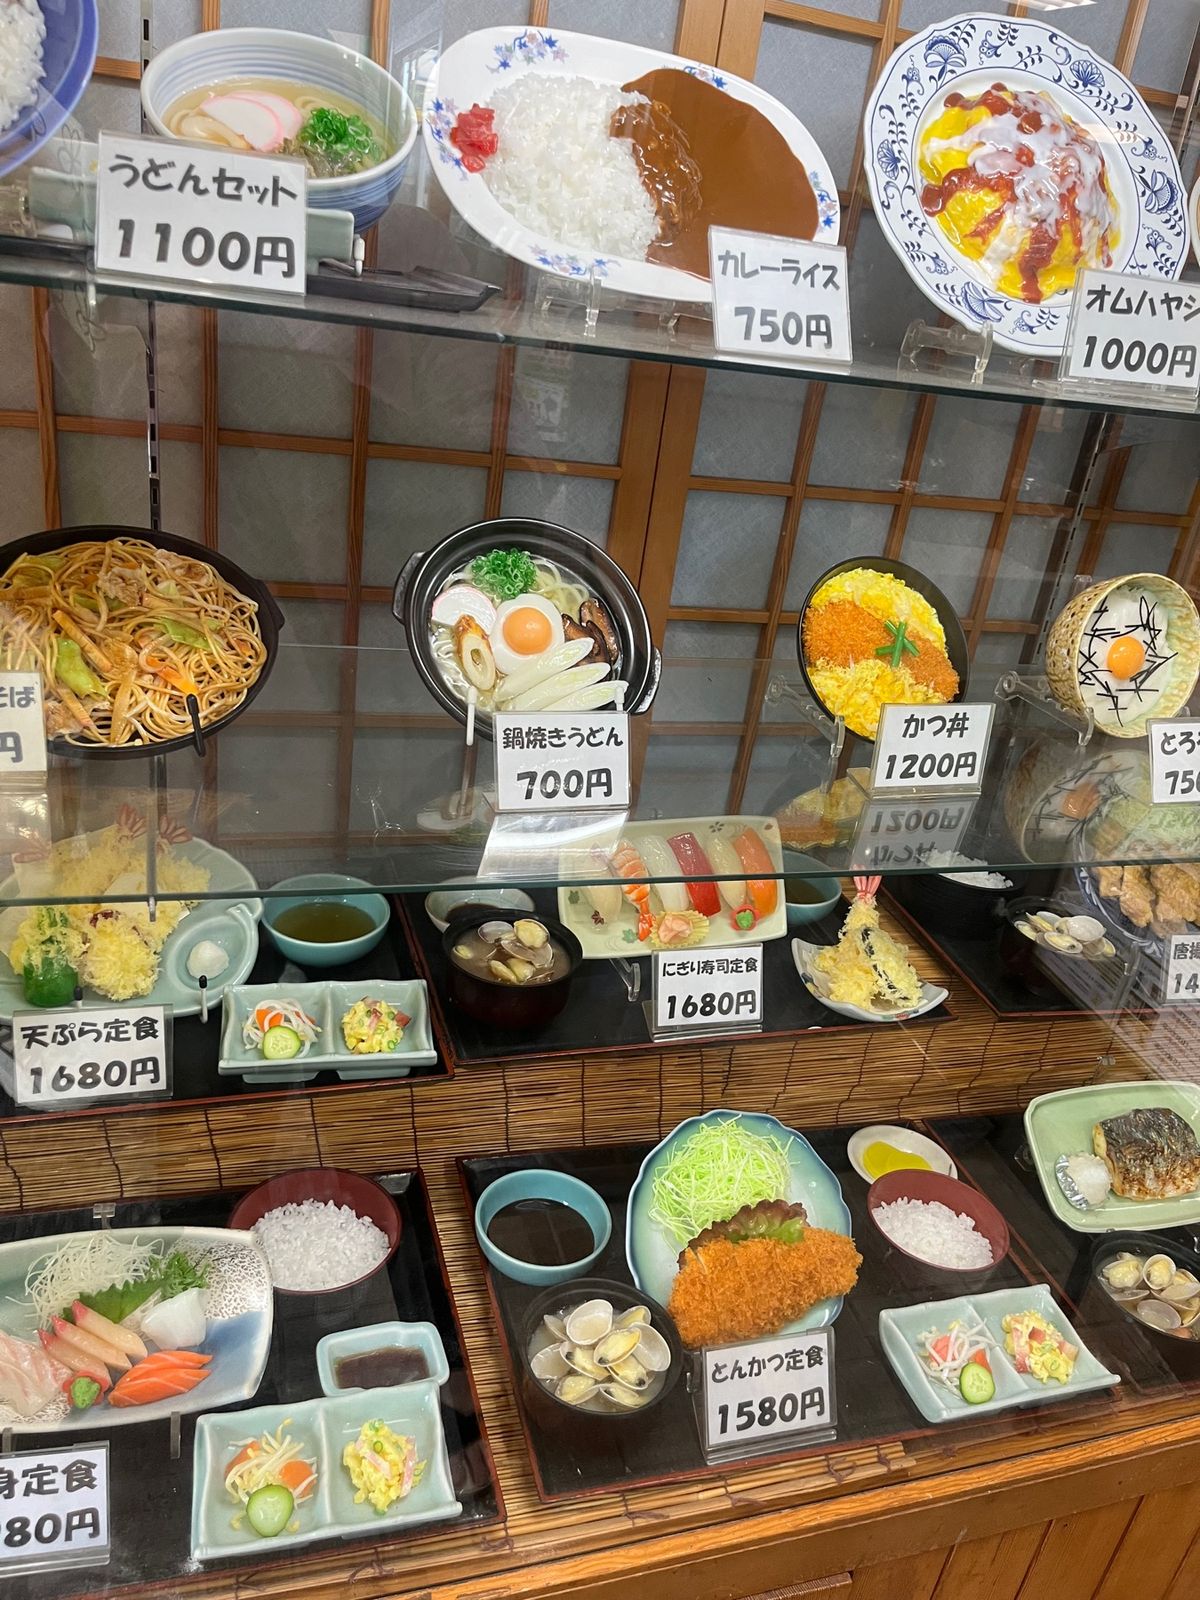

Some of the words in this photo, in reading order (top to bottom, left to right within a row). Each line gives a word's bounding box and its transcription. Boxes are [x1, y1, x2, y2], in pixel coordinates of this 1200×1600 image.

[108, 154, 297, 207] うどんセット
[118, 218, 296, 278] 1100円
[718, 250, 840, 291] カレーライス
[734, 306, 833, 349] 750円
[1083, 336, 1197, 378] 1000円
[502, 726, 624, 750] 鍋焼きうどん
[902, 712, 970, 738] かつ丼
[1160, 731, 1200, 756] とろ
[885, 751, 977, 780] 1200円
[1165, 769, 1200, 795] 75
[516, 767, 613, 800] 700円
[662, 957, 758, 977] にぎり寿司定食
[667, 989, 757, 1020] 1680円
[20, 1016, 160, 1050] 天ぷら定食
[30, 1056, 161, 1094] 1680円
[711, 1345, 823, 1383] とんかつ定食
[718, 1386, 825, 1435] 1580円
